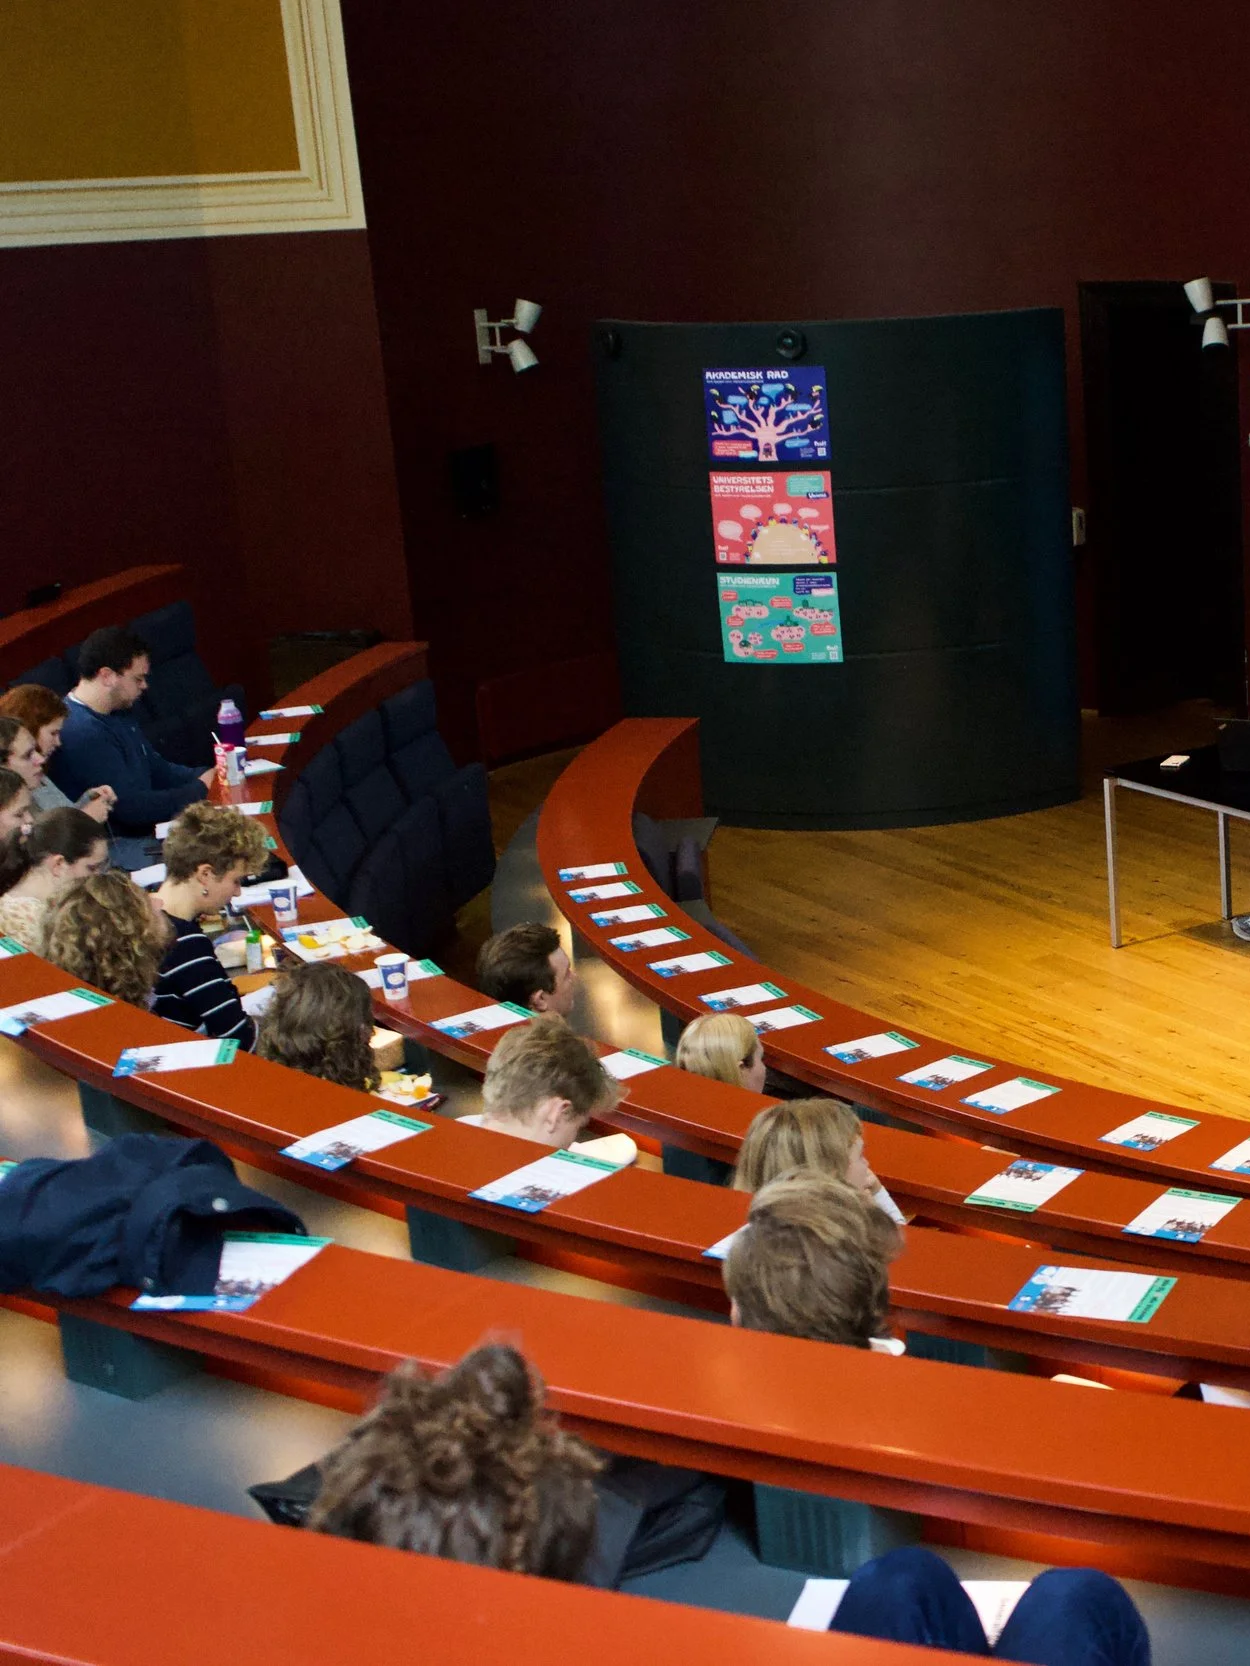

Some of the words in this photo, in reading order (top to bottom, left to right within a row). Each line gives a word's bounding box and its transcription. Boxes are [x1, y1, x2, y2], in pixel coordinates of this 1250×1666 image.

[705, 371, 763, 380] AKADEMISK
[712, 476, 774, 485] UNIVERSITETS
[713, 485, 775, 494] BESTYRELSEN
